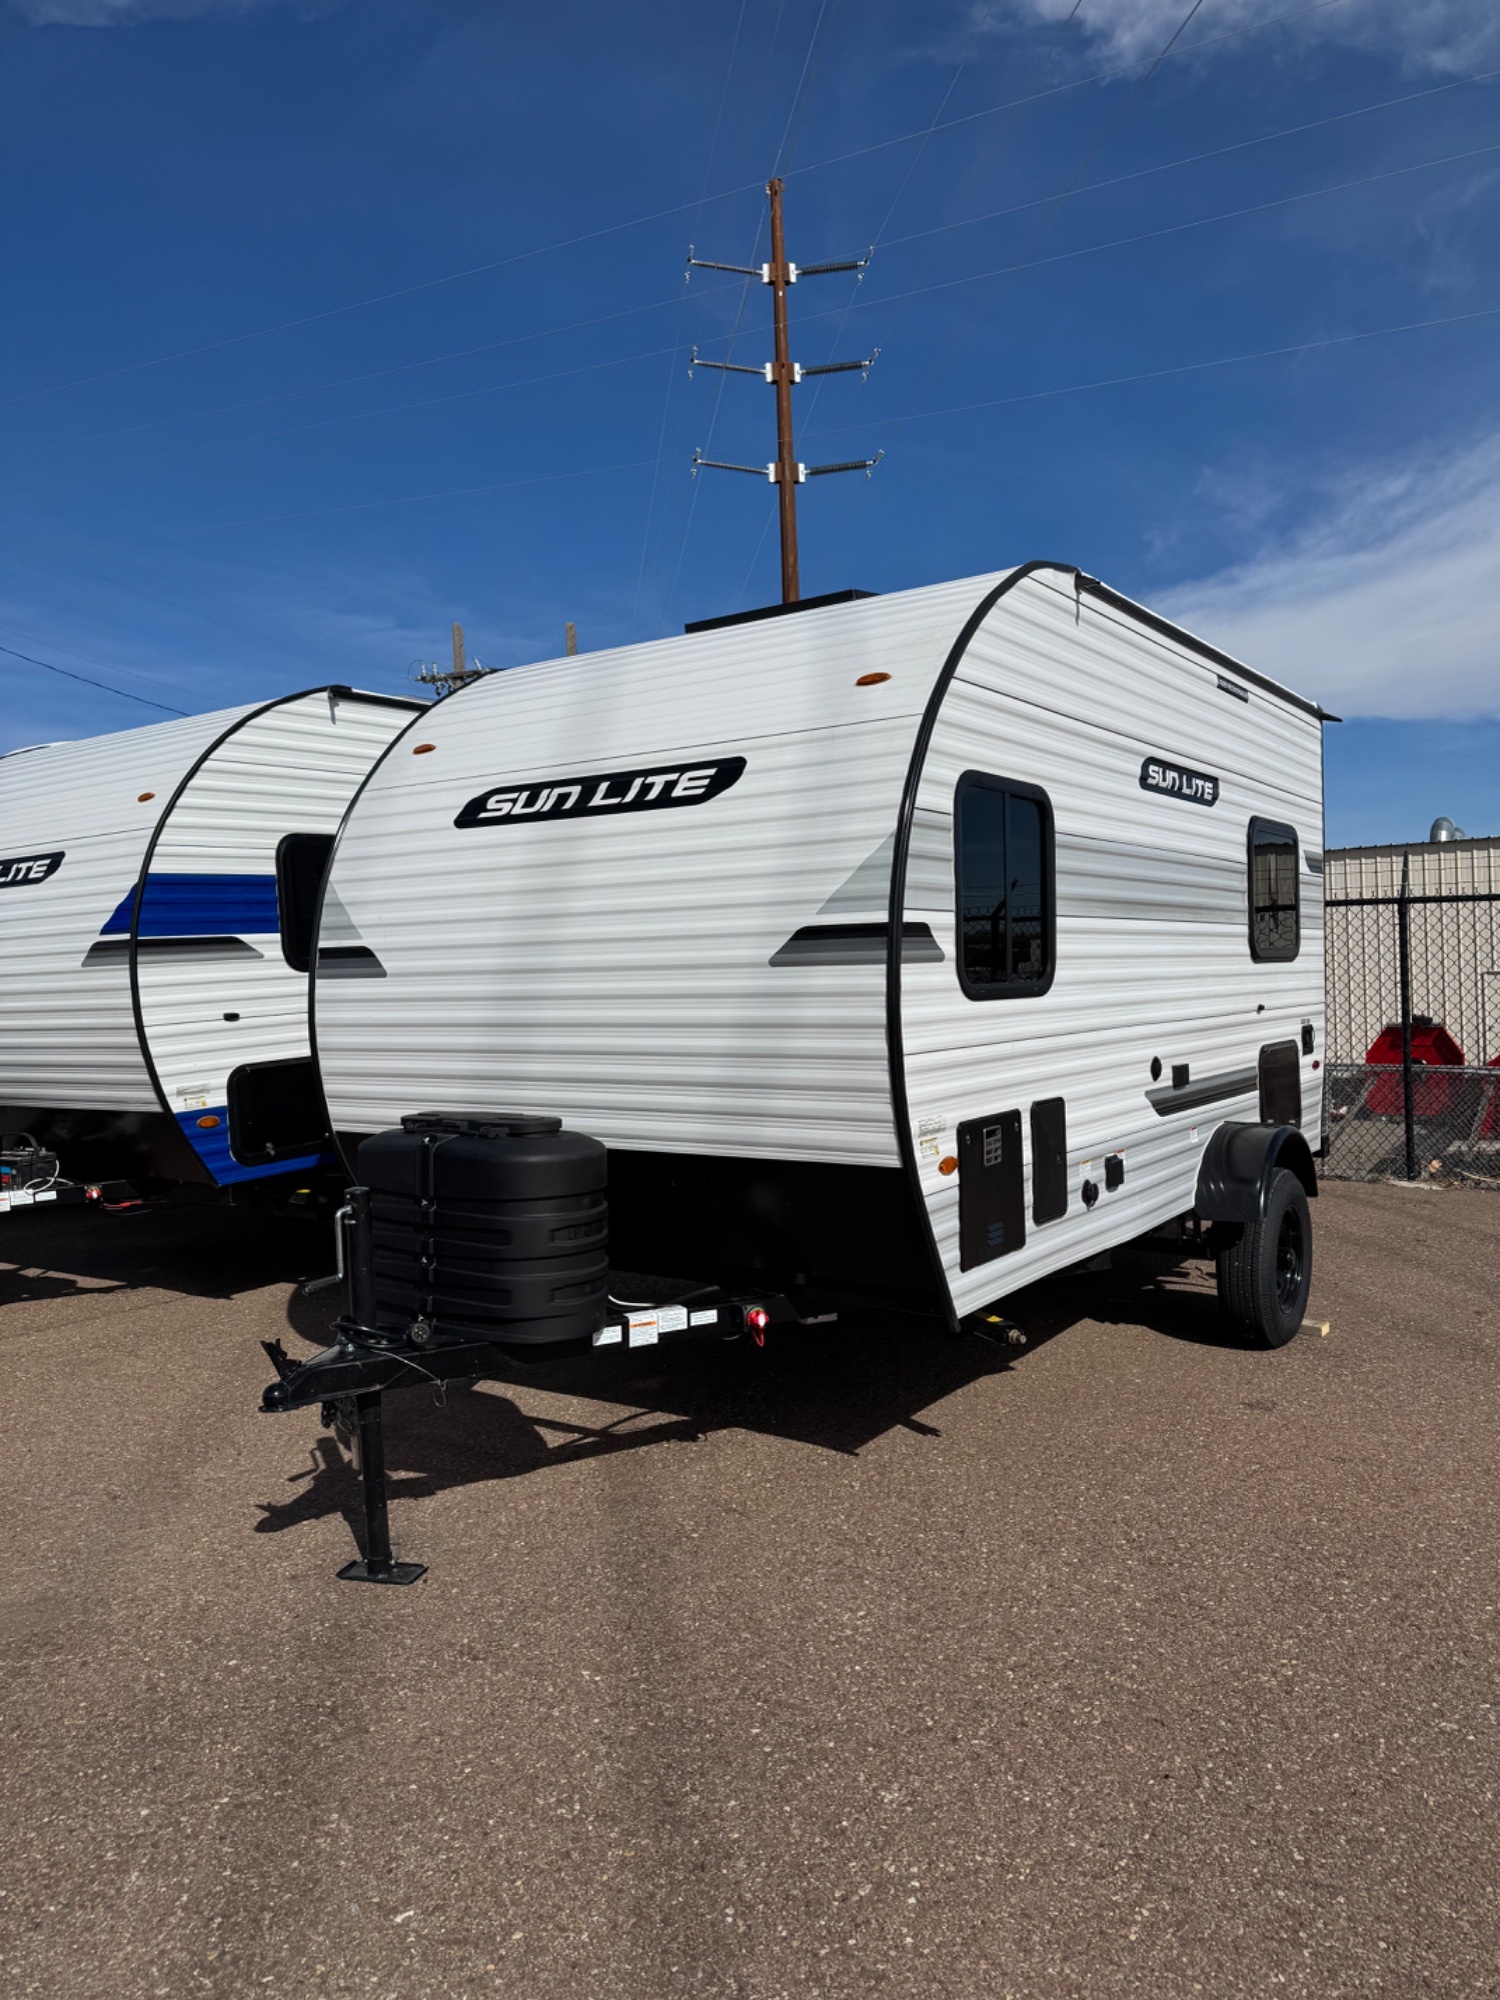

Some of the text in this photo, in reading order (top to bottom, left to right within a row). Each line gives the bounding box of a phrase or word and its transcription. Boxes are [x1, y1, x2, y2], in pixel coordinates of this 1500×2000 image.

[477, 767, 718, 818] SUN LITE
[1146, 764, 1213, 801] SUN LITE
